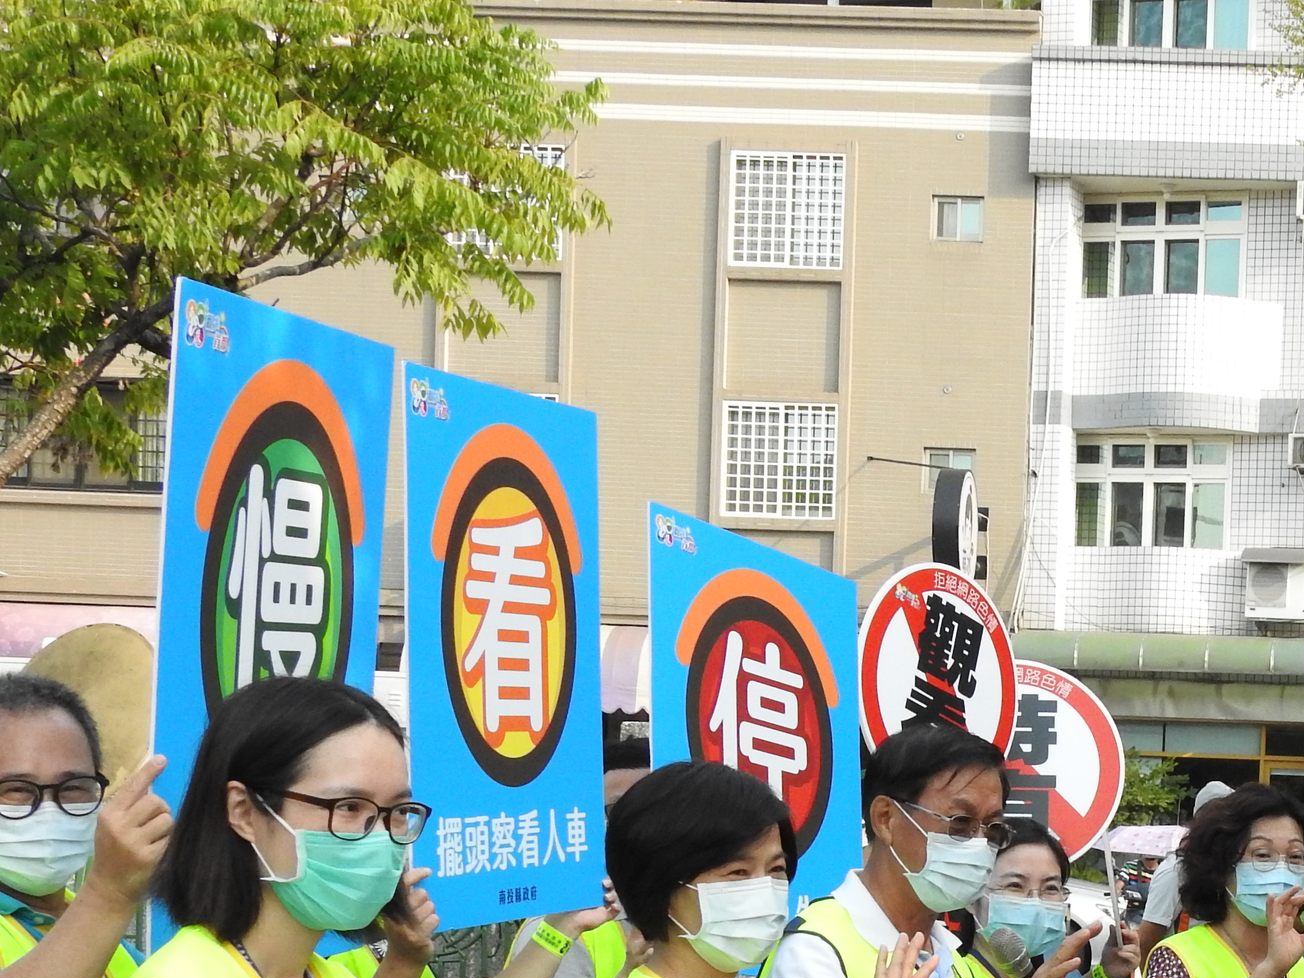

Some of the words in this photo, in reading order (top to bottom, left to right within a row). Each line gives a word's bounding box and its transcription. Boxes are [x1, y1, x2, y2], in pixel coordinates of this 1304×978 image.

[228, 464, 324, 690] 慢
[464, 517, 551, 733] 看
[933, 571, 1000, 634] 拒絕網路色情
[709, 630, 808, 801] 停
[436, 806, 588, 878] 擺頭察看人車
